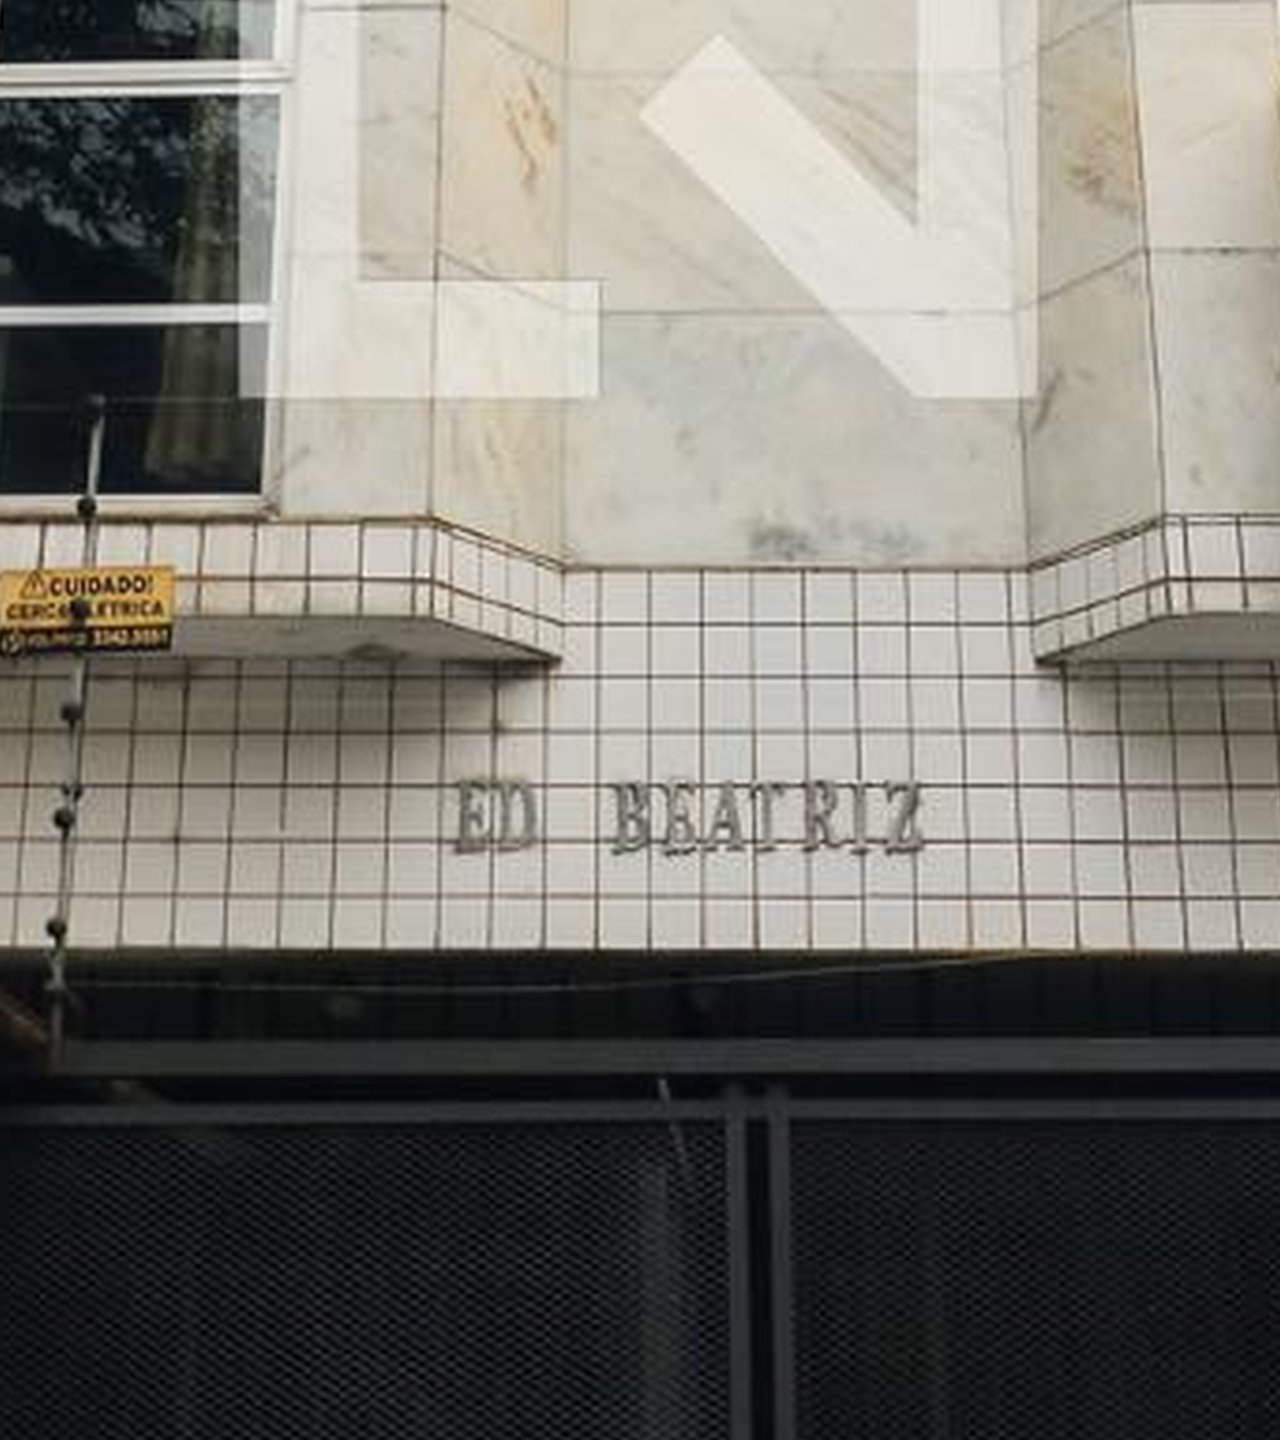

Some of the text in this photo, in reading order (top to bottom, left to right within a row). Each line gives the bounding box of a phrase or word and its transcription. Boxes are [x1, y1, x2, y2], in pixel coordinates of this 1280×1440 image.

[49, 575, 153, 596] CUIDADO!
[455, 780, 924, 855] ED BEATRIZ
